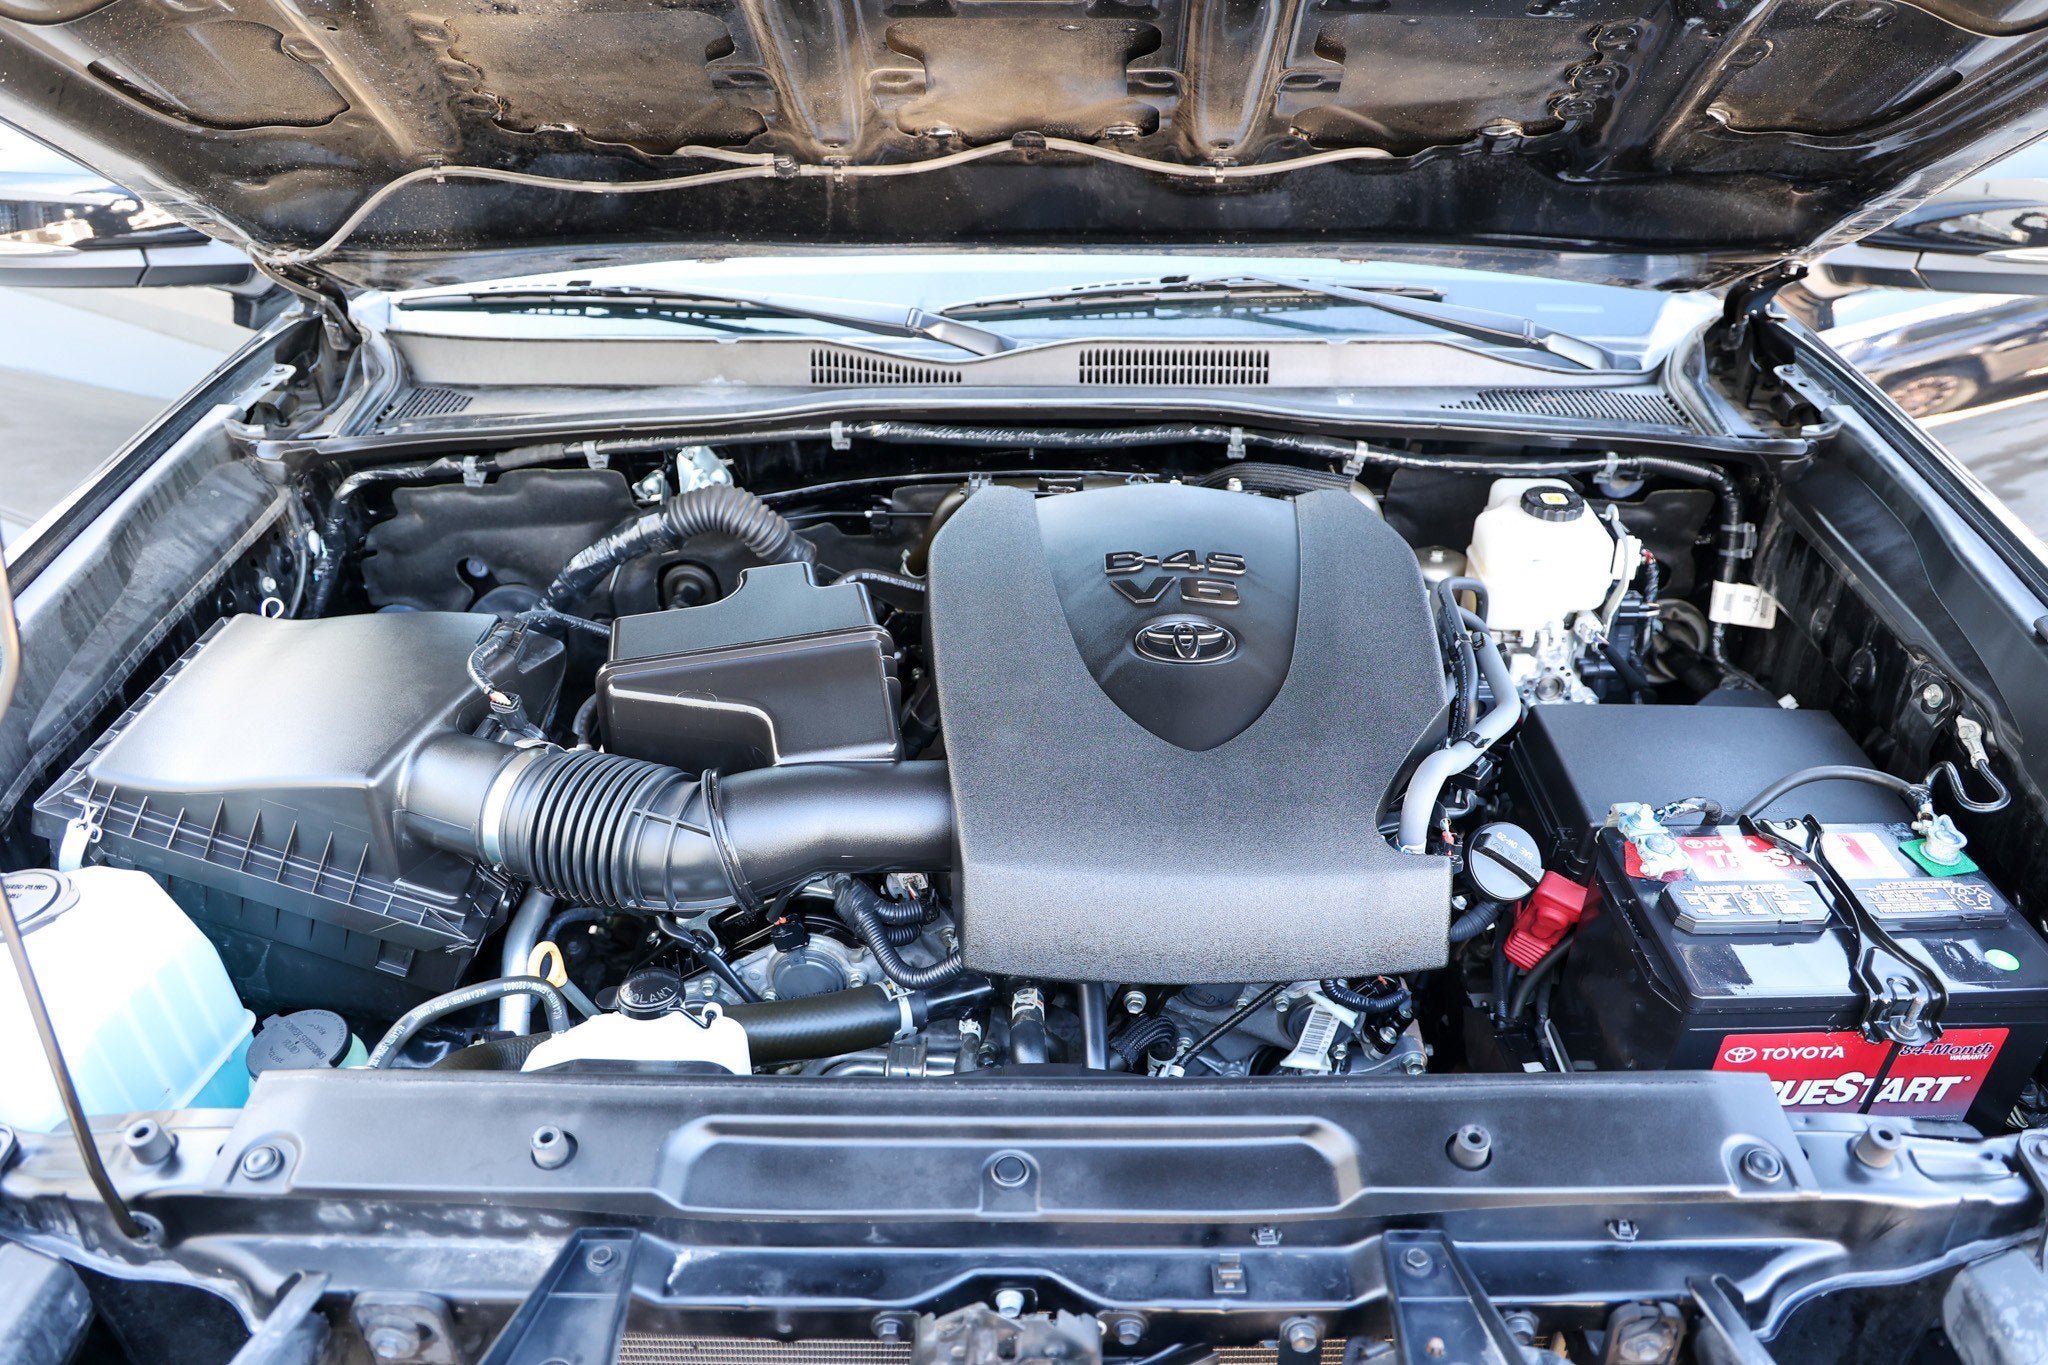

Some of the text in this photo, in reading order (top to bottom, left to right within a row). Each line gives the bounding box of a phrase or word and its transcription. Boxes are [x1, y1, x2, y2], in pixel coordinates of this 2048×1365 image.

[1104, 550, 1246, 574] D-4S
[1109, 576, 1241, 606] V6
[1761, 1043, 1994, 1060] TOYOTA 84-Month
